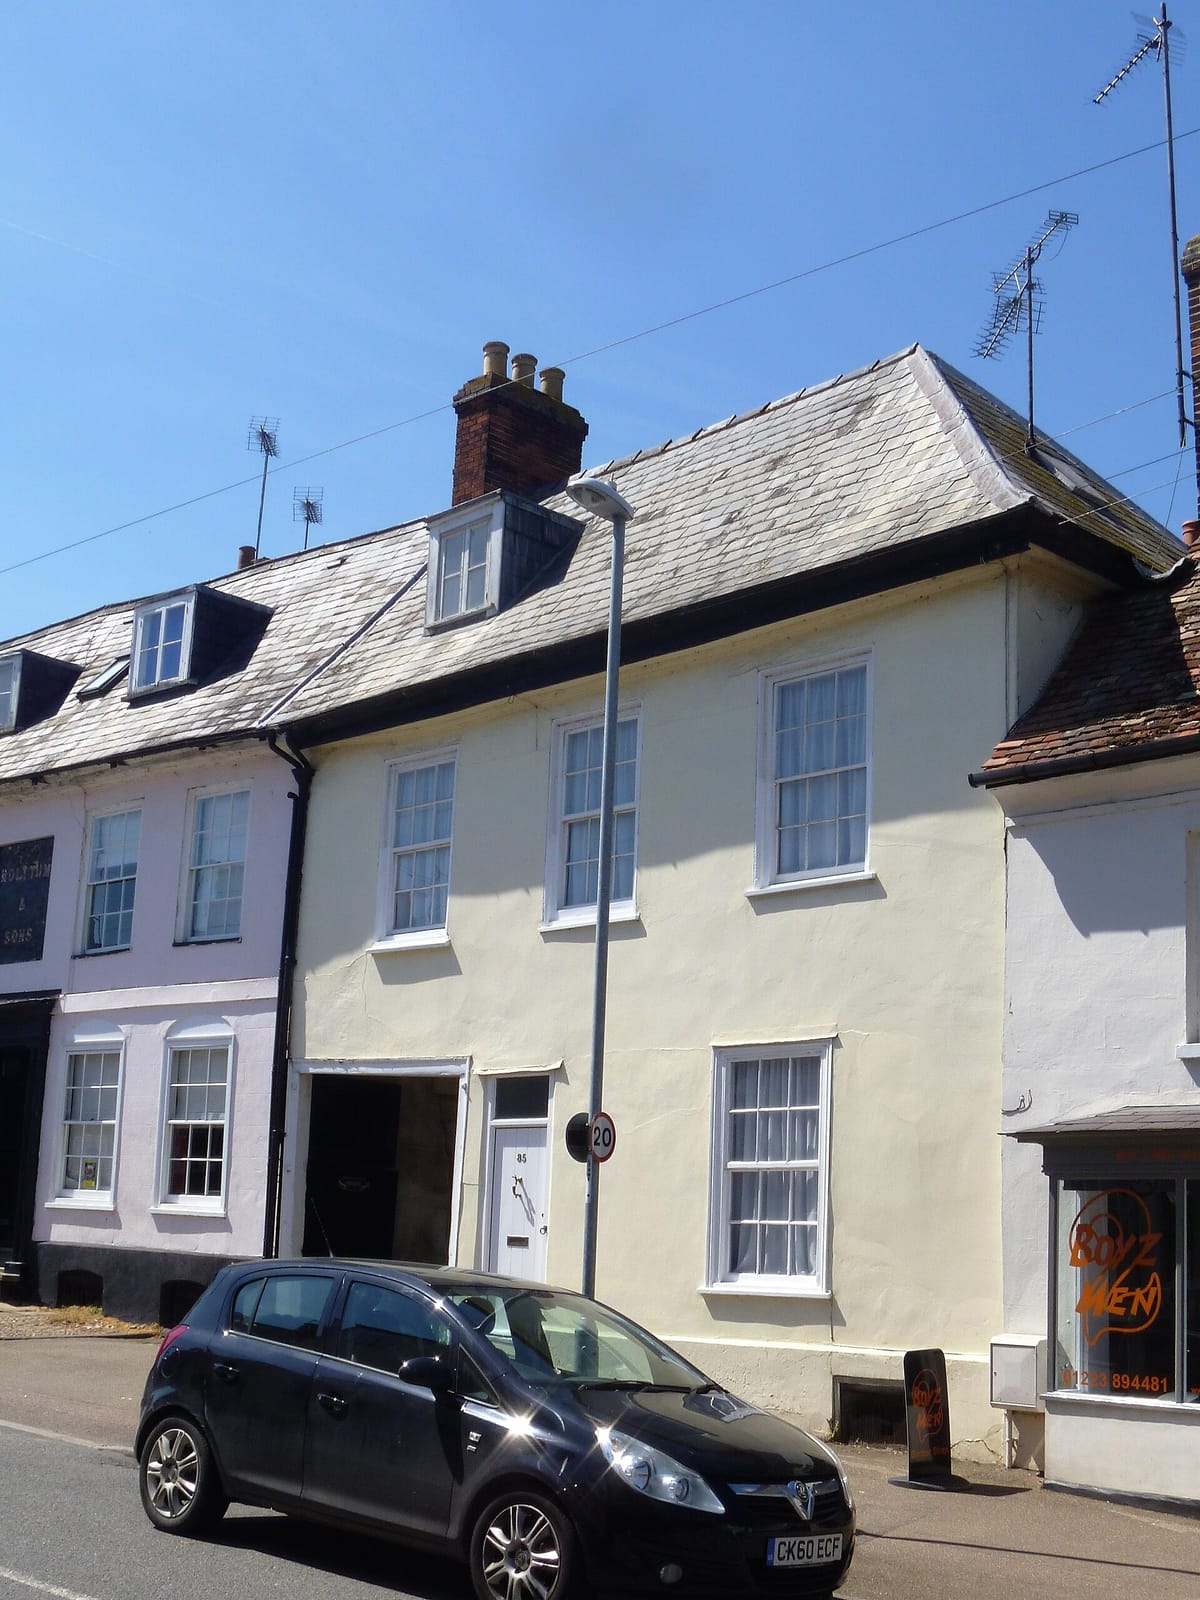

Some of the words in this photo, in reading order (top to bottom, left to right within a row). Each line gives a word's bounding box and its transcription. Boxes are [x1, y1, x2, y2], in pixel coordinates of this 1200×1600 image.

[4, 928, 33, 944] SONS
[594, 1126, 612, 1147] 20
[517, 1153, 527, 1164] 85
[1062, 1368, 1107, 1388] 01223
[1112, 1373, 1168, 1393] 894481
[777, 1541, 814, 1561] CK60
[817, 1537, 840, 1558] ECF
